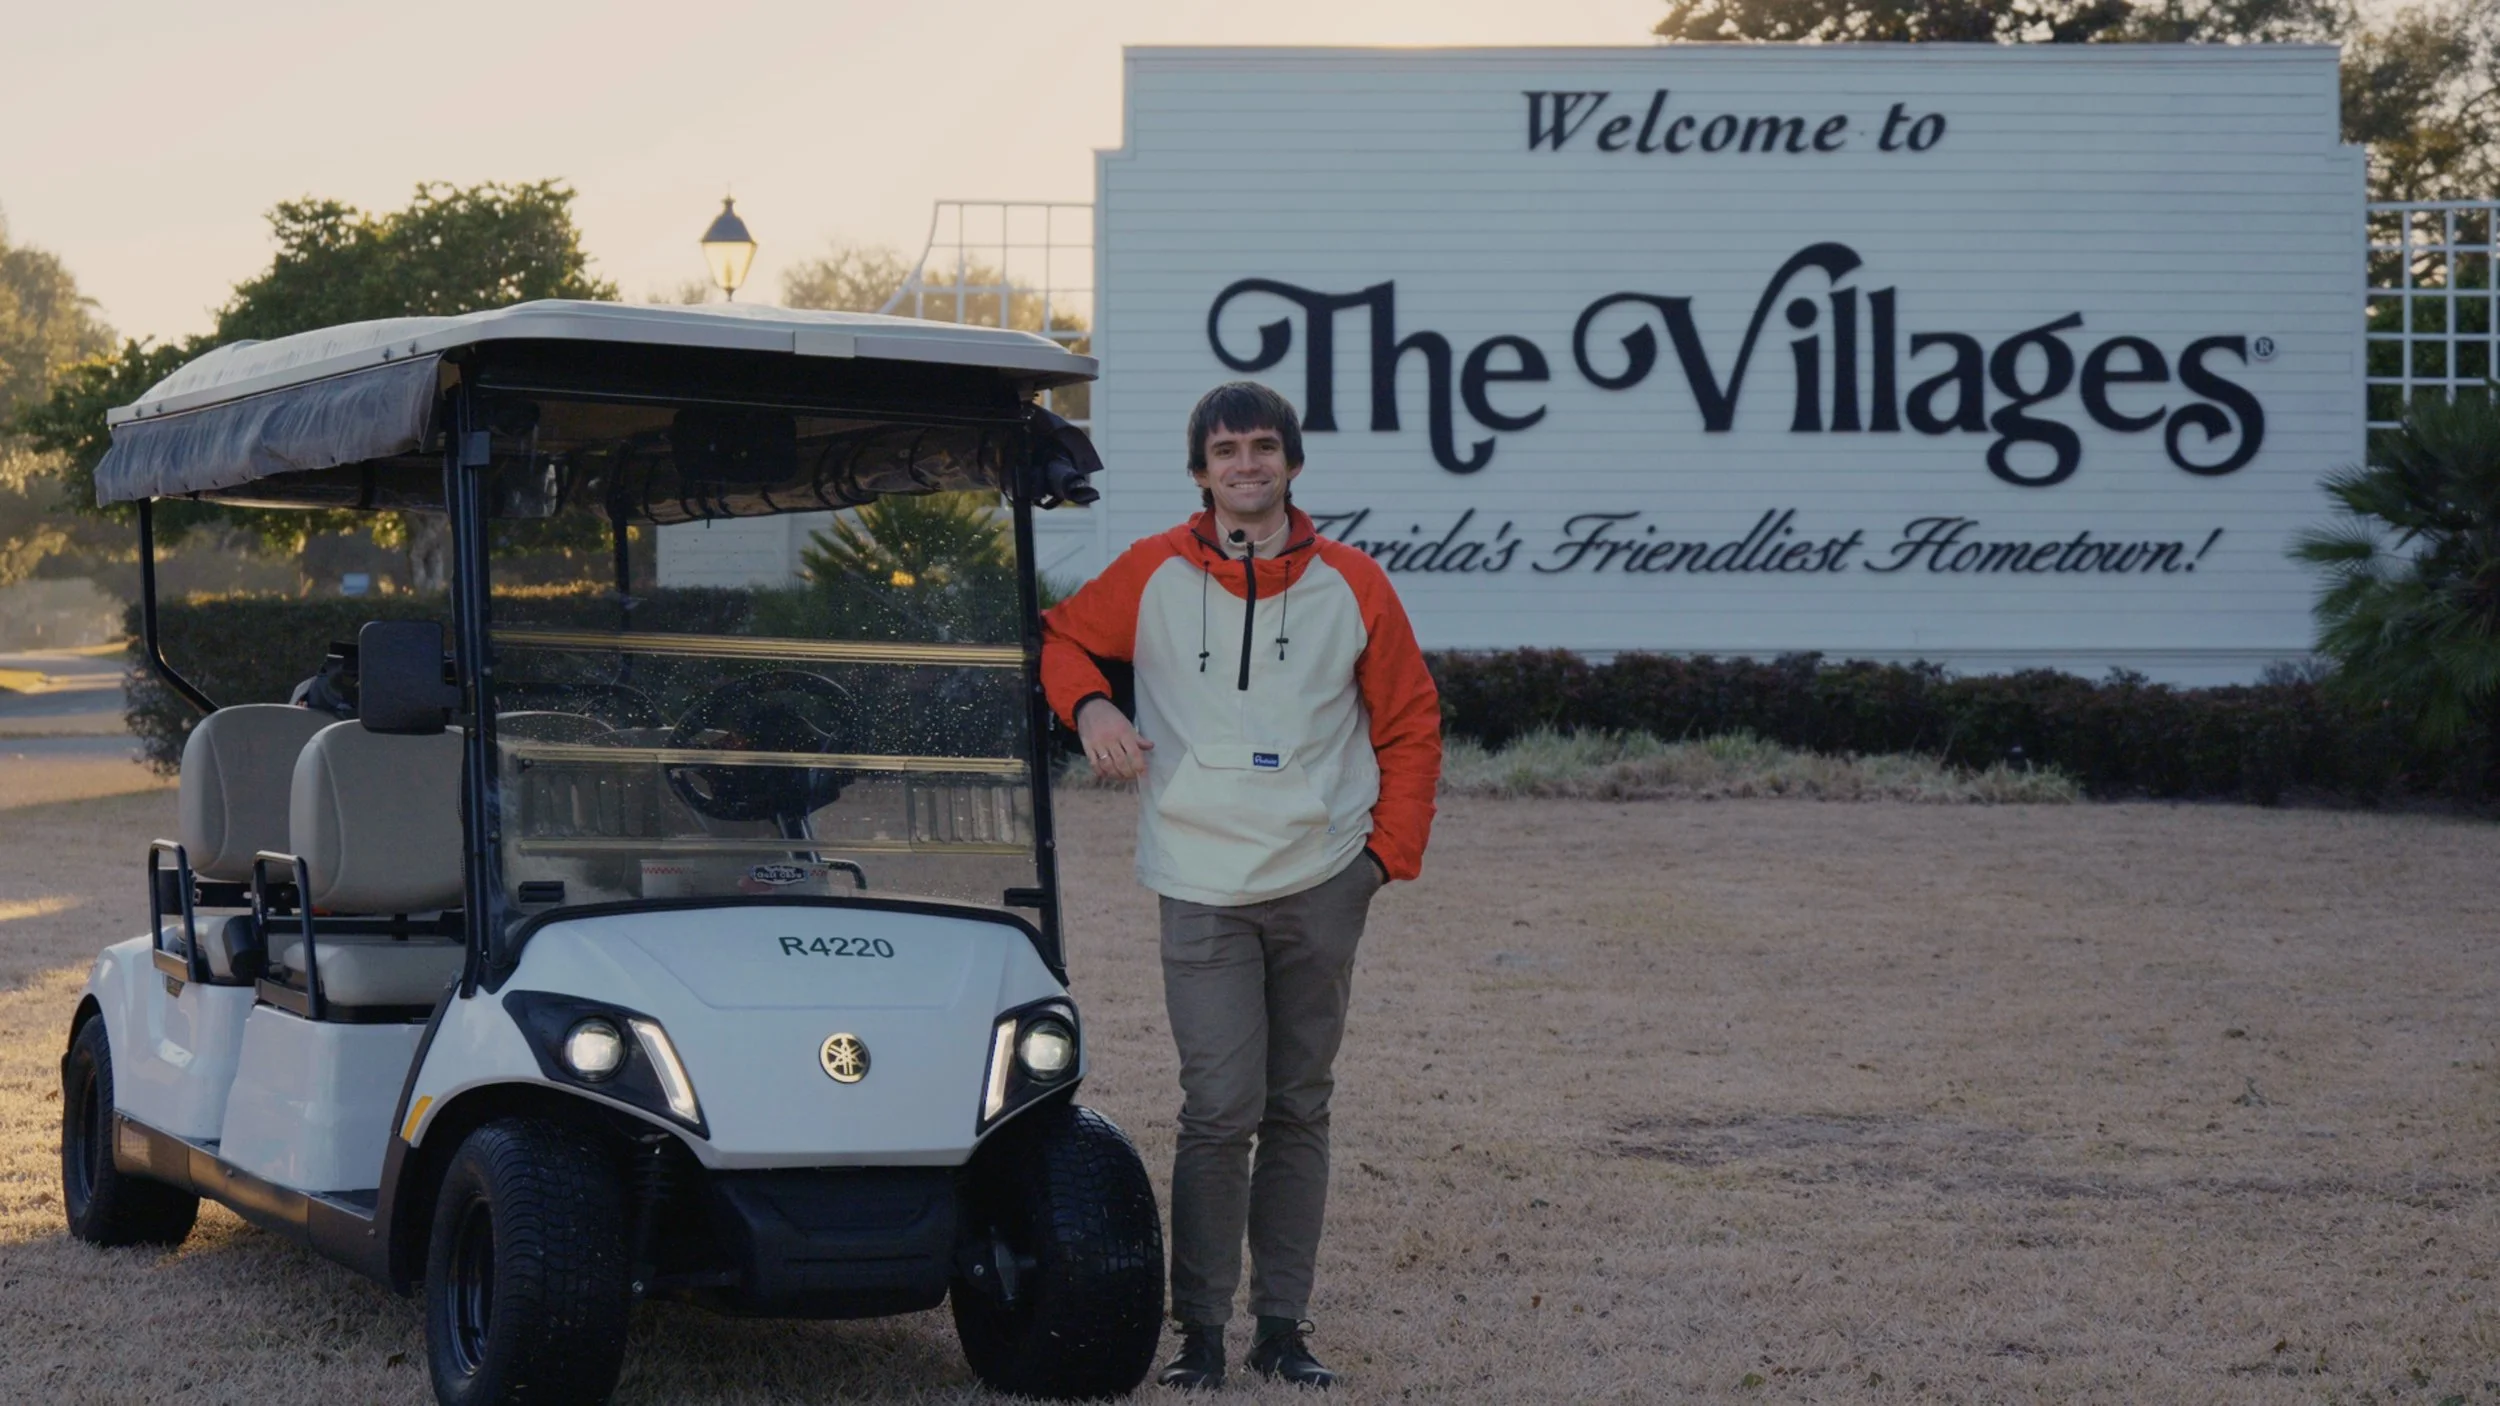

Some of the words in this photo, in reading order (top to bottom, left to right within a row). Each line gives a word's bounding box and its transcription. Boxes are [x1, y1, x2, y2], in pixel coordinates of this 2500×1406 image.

[1521, 88, 1849, 154] Welcome
[1877, 101, 1947, 153] to
[1207, 277, 1550, 475] The
[1531, 507, 1865, 574] Friendliest
[1862, 515, 2224, 574] Hometown!
[778, 936, 895, 959] R4220
